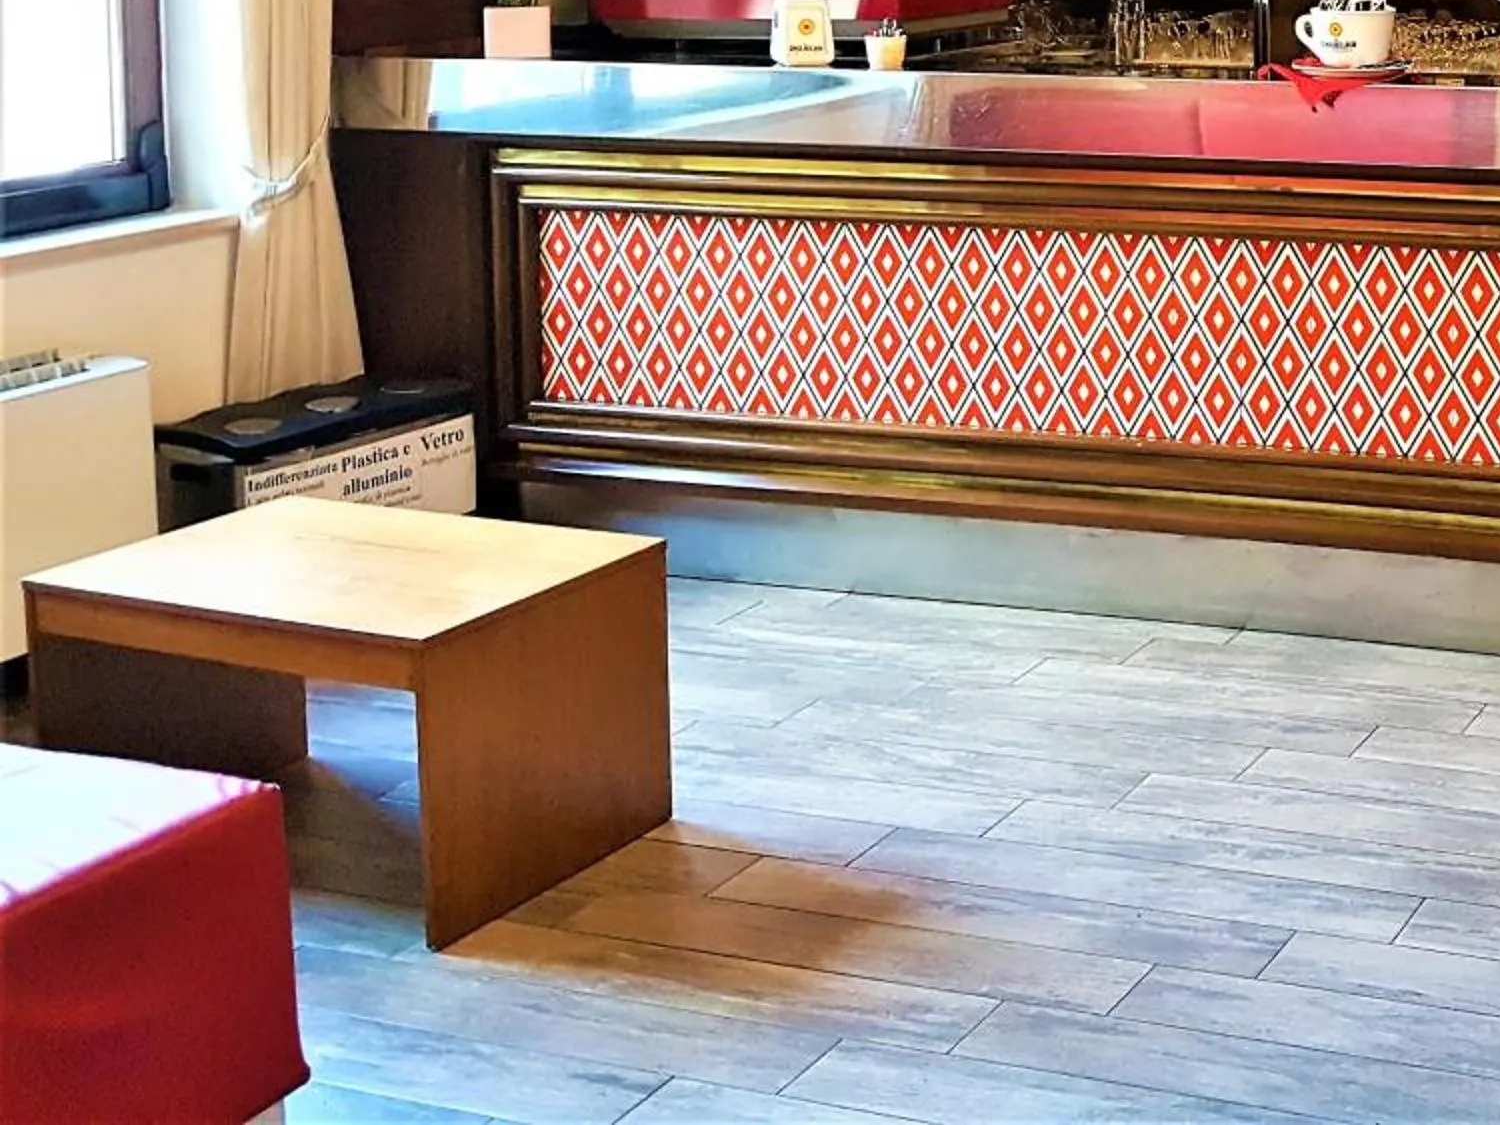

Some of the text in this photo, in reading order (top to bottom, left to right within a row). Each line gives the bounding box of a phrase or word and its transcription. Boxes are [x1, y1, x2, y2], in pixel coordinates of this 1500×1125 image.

[421, 428, 465, 451] Vetro
[342, 446, 399, 473] Plastica
[343, 464, 413, 496] alluminio
